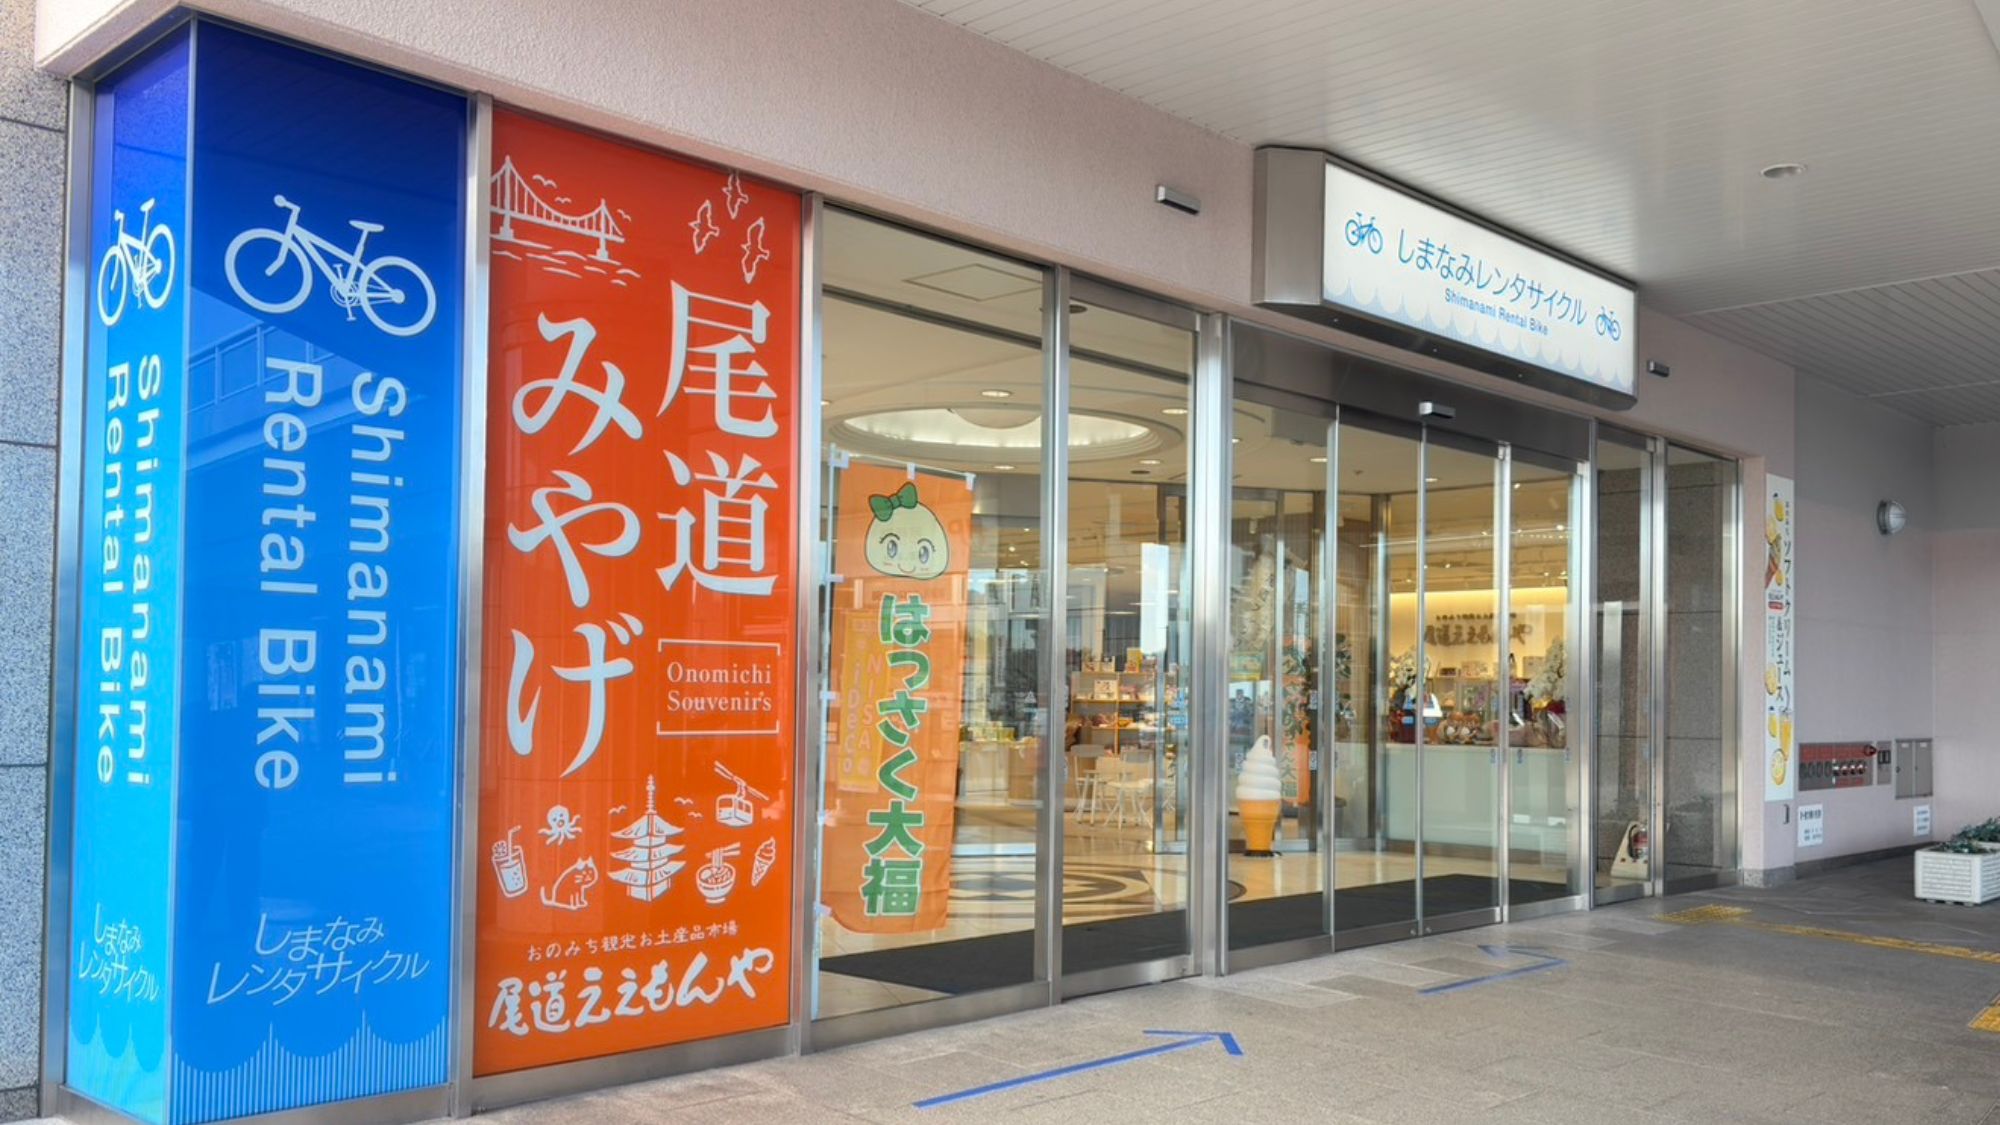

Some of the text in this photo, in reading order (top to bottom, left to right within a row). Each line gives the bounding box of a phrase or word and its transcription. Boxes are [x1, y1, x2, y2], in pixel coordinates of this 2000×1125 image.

[1398, 229, 1587, 326] しまなみレンタサイクル
[1445, 288, 1548, 335] Shimanami Rental Bike
[655, 279, 779, 596] 尾道
[97, 363, 130, 784] Rental Bike
[127, 353, 161, 786] Shimanami
[255, 357, 322, 789] Rental Bike
[343, 373, 407, 784] Shimanami
[507, 311, 644, 778] みやげ
[666, 661, 772, 685] Onomichi
[860, 593, 931, 915] はっさく大福
[79, 941, 158, 1001] レンタサイクル
[95, 903, 143, 957] しまなみ
[255, 913, 384, 961] しまなみ
[528, 920, 739, 962] おのみち観光お土産品市場
[206, 951, 430, 1006] レンタサイクル
[488, 947, 774, 1036] 尾道ええもんや
